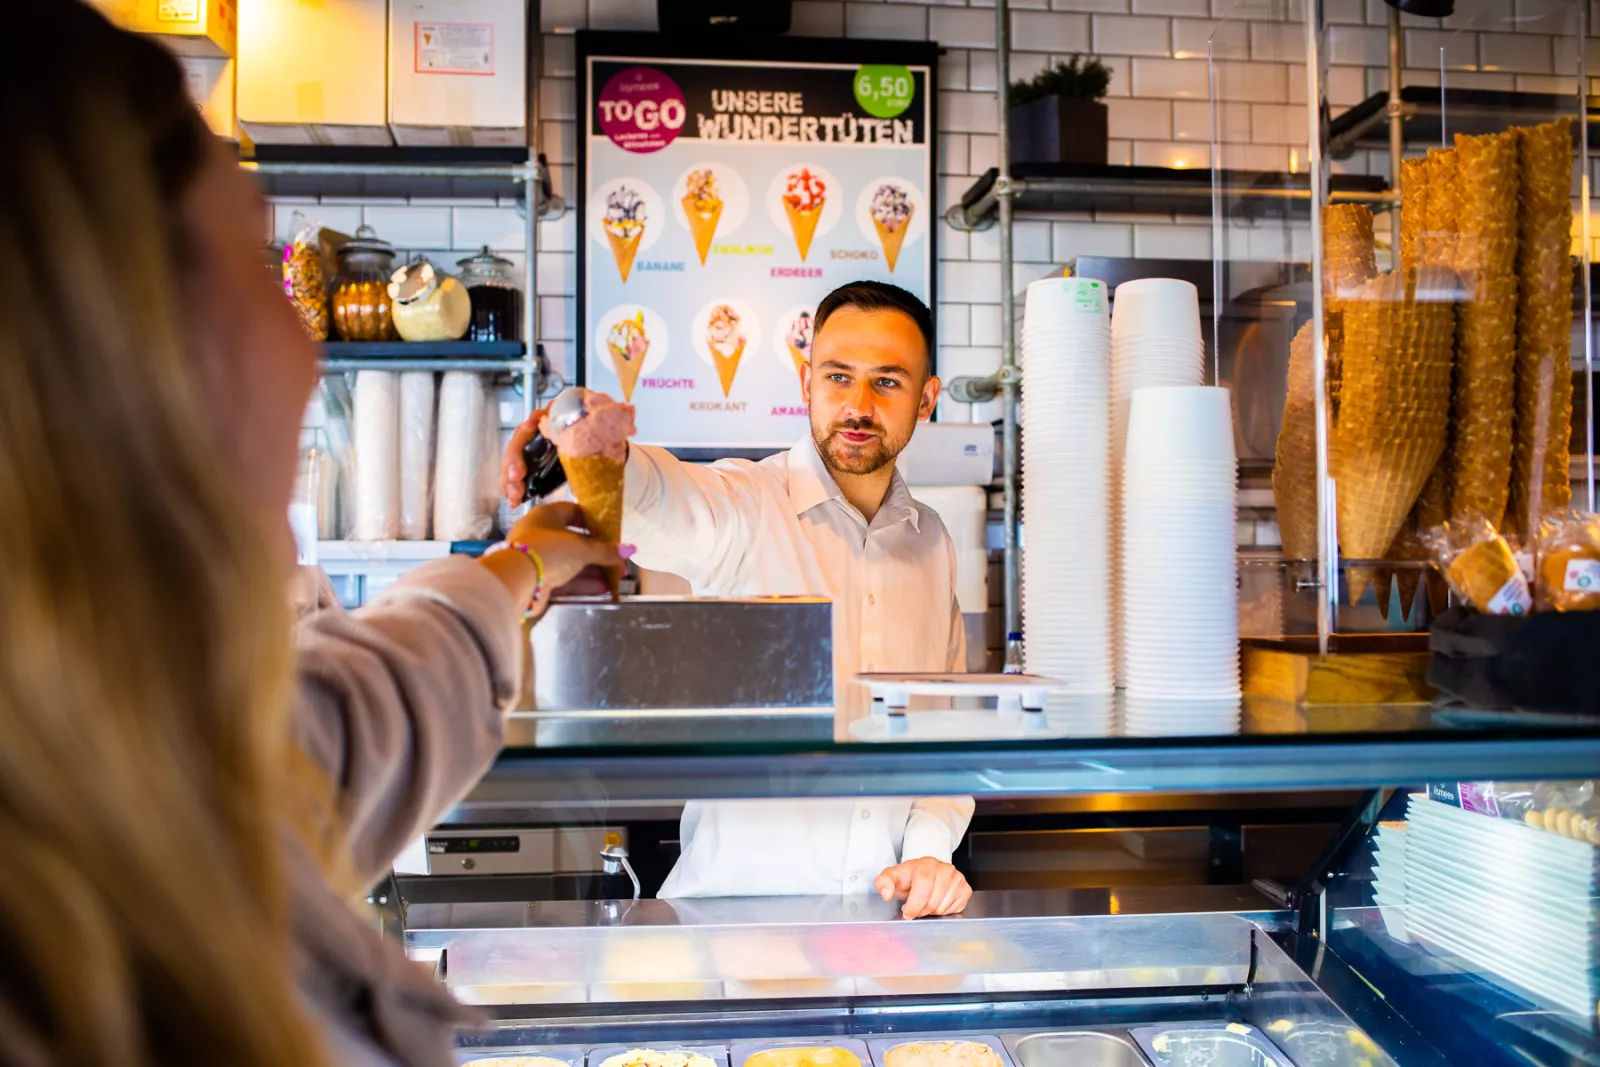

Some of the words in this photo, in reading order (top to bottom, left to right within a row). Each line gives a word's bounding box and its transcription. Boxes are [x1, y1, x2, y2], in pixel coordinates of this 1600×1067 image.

[858, 75, 909, 101] 6,50
[711, 89, 804, 114] UNSERE
[697, 113, 914, 144] WUNDERTÜTEN
[830, 249, 878, 260] SCHOKO
[636, 261, 686, 272] BANANE
[770, 267, 823, 278] ERDBEER
[642, 378, 695, 389] FRÜCHTE
[689, 402, 748, 412] KROKANT
